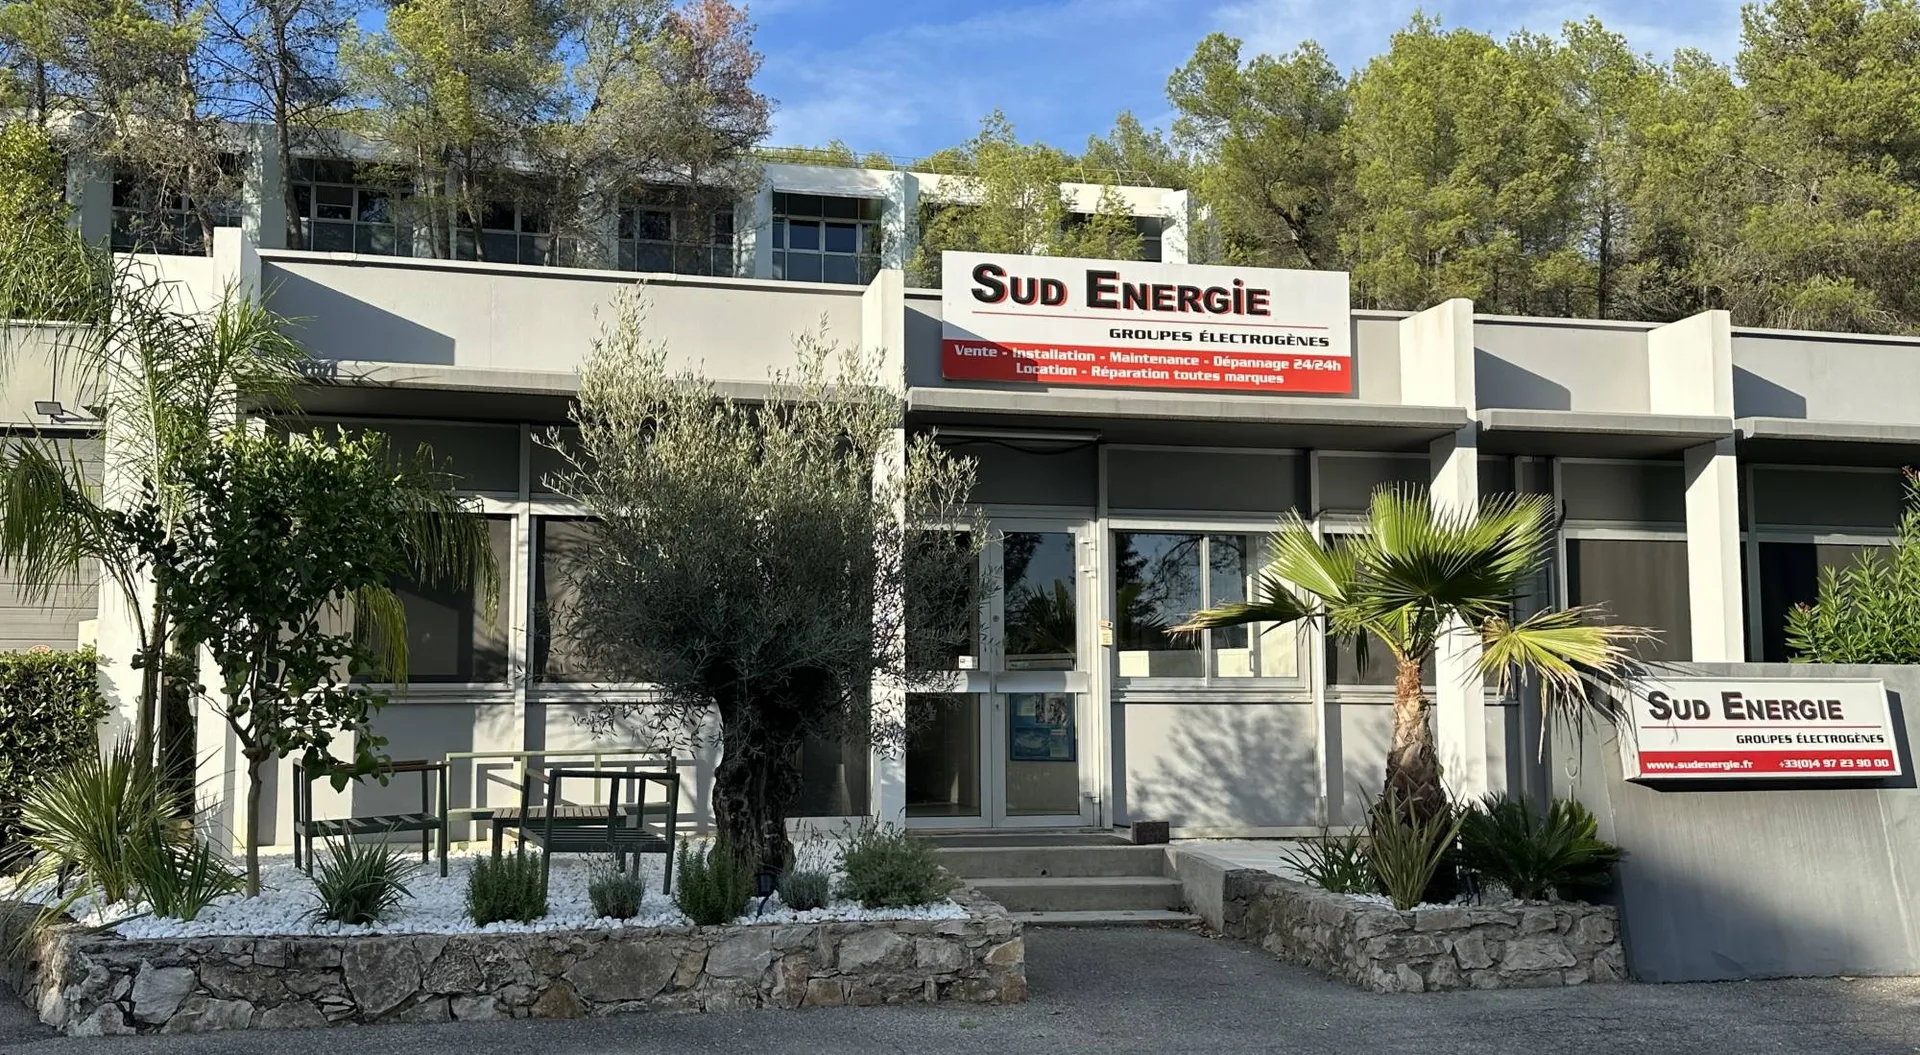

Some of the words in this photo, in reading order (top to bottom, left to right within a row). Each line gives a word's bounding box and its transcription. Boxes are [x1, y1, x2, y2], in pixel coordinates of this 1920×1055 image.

[971, 263, 1068, 306] SUD
[1109, 328, 1192, 342] GROUPES
[1199, 329, 1330, 347] ÉLECTROGÈNES
[954, 344, 998, 358] Vente
[1012, 347, 1095, 362] Installation
[1109, 351, 1199, 365] Maintenance
[1213, 355, 1289, 370] Dépannage
[1293, 358, 1341, 371] 24/24h
[1016, 362, 1077, 376] Location
[1091, 365, 1169, 380] Réparation
[1173, 369, 1220, 381] toutes
[1225, 373, 1284, 385] marques
[1648, 690, 1711, 720] SUD
[1721, 691, 1844, 720] ENERGIE
[1736, 734, 1793, 744] GROUPES
[1796, 732, 1885, 744] ÉLECTROGÈNES
[1646, 759, 1753, 771] www.sudenergie.fr
[1779, 758, 1820, 769] +33(0)4
[1823, 758, 1837, 768] 97
[1840, 758, 1854, 768] 23
[1856, 758, 1871, 768] 90
[1874, 758, 1889, 768] 00
